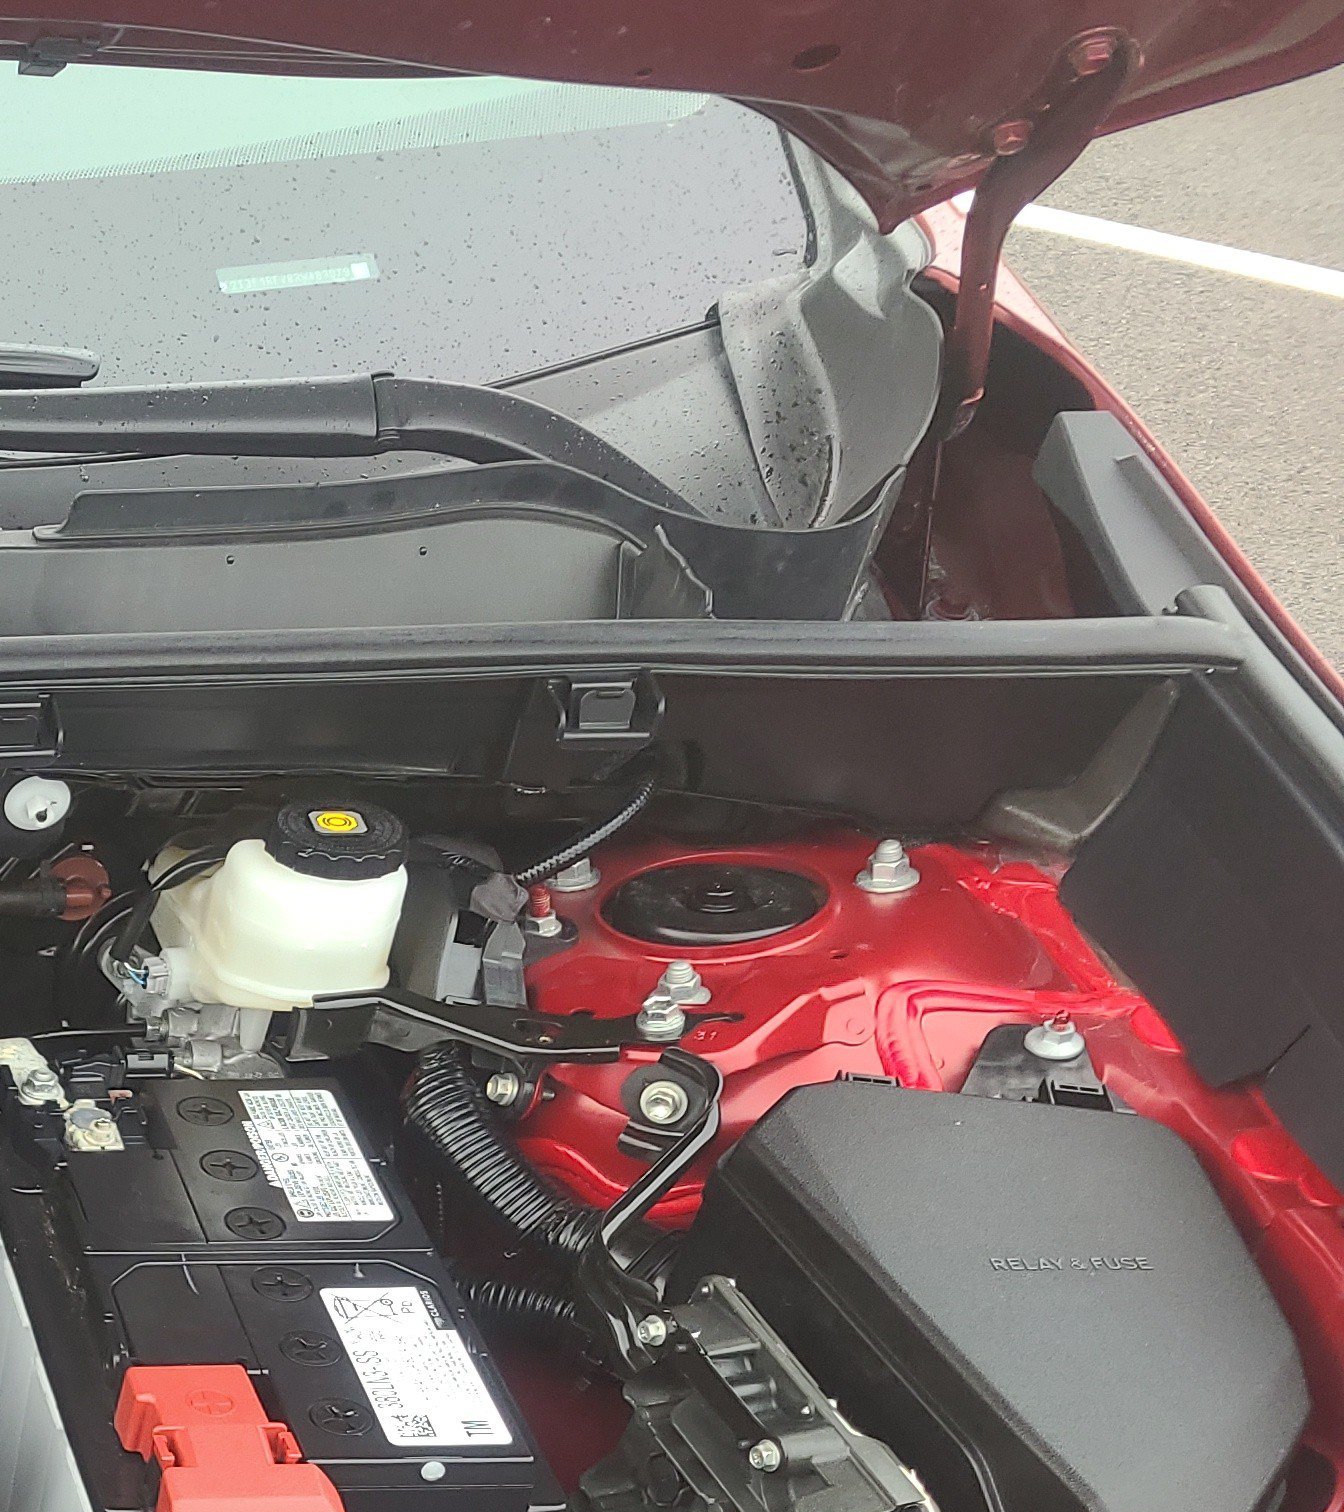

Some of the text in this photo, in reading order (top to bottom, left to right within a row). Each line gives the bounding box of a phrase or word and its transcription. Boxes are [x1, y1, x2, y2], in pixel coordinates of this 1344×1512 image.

[989, 1256, 1154, 1271] RELAY & FUSE
[419, 1290, 440, 1317] CLARIOS
